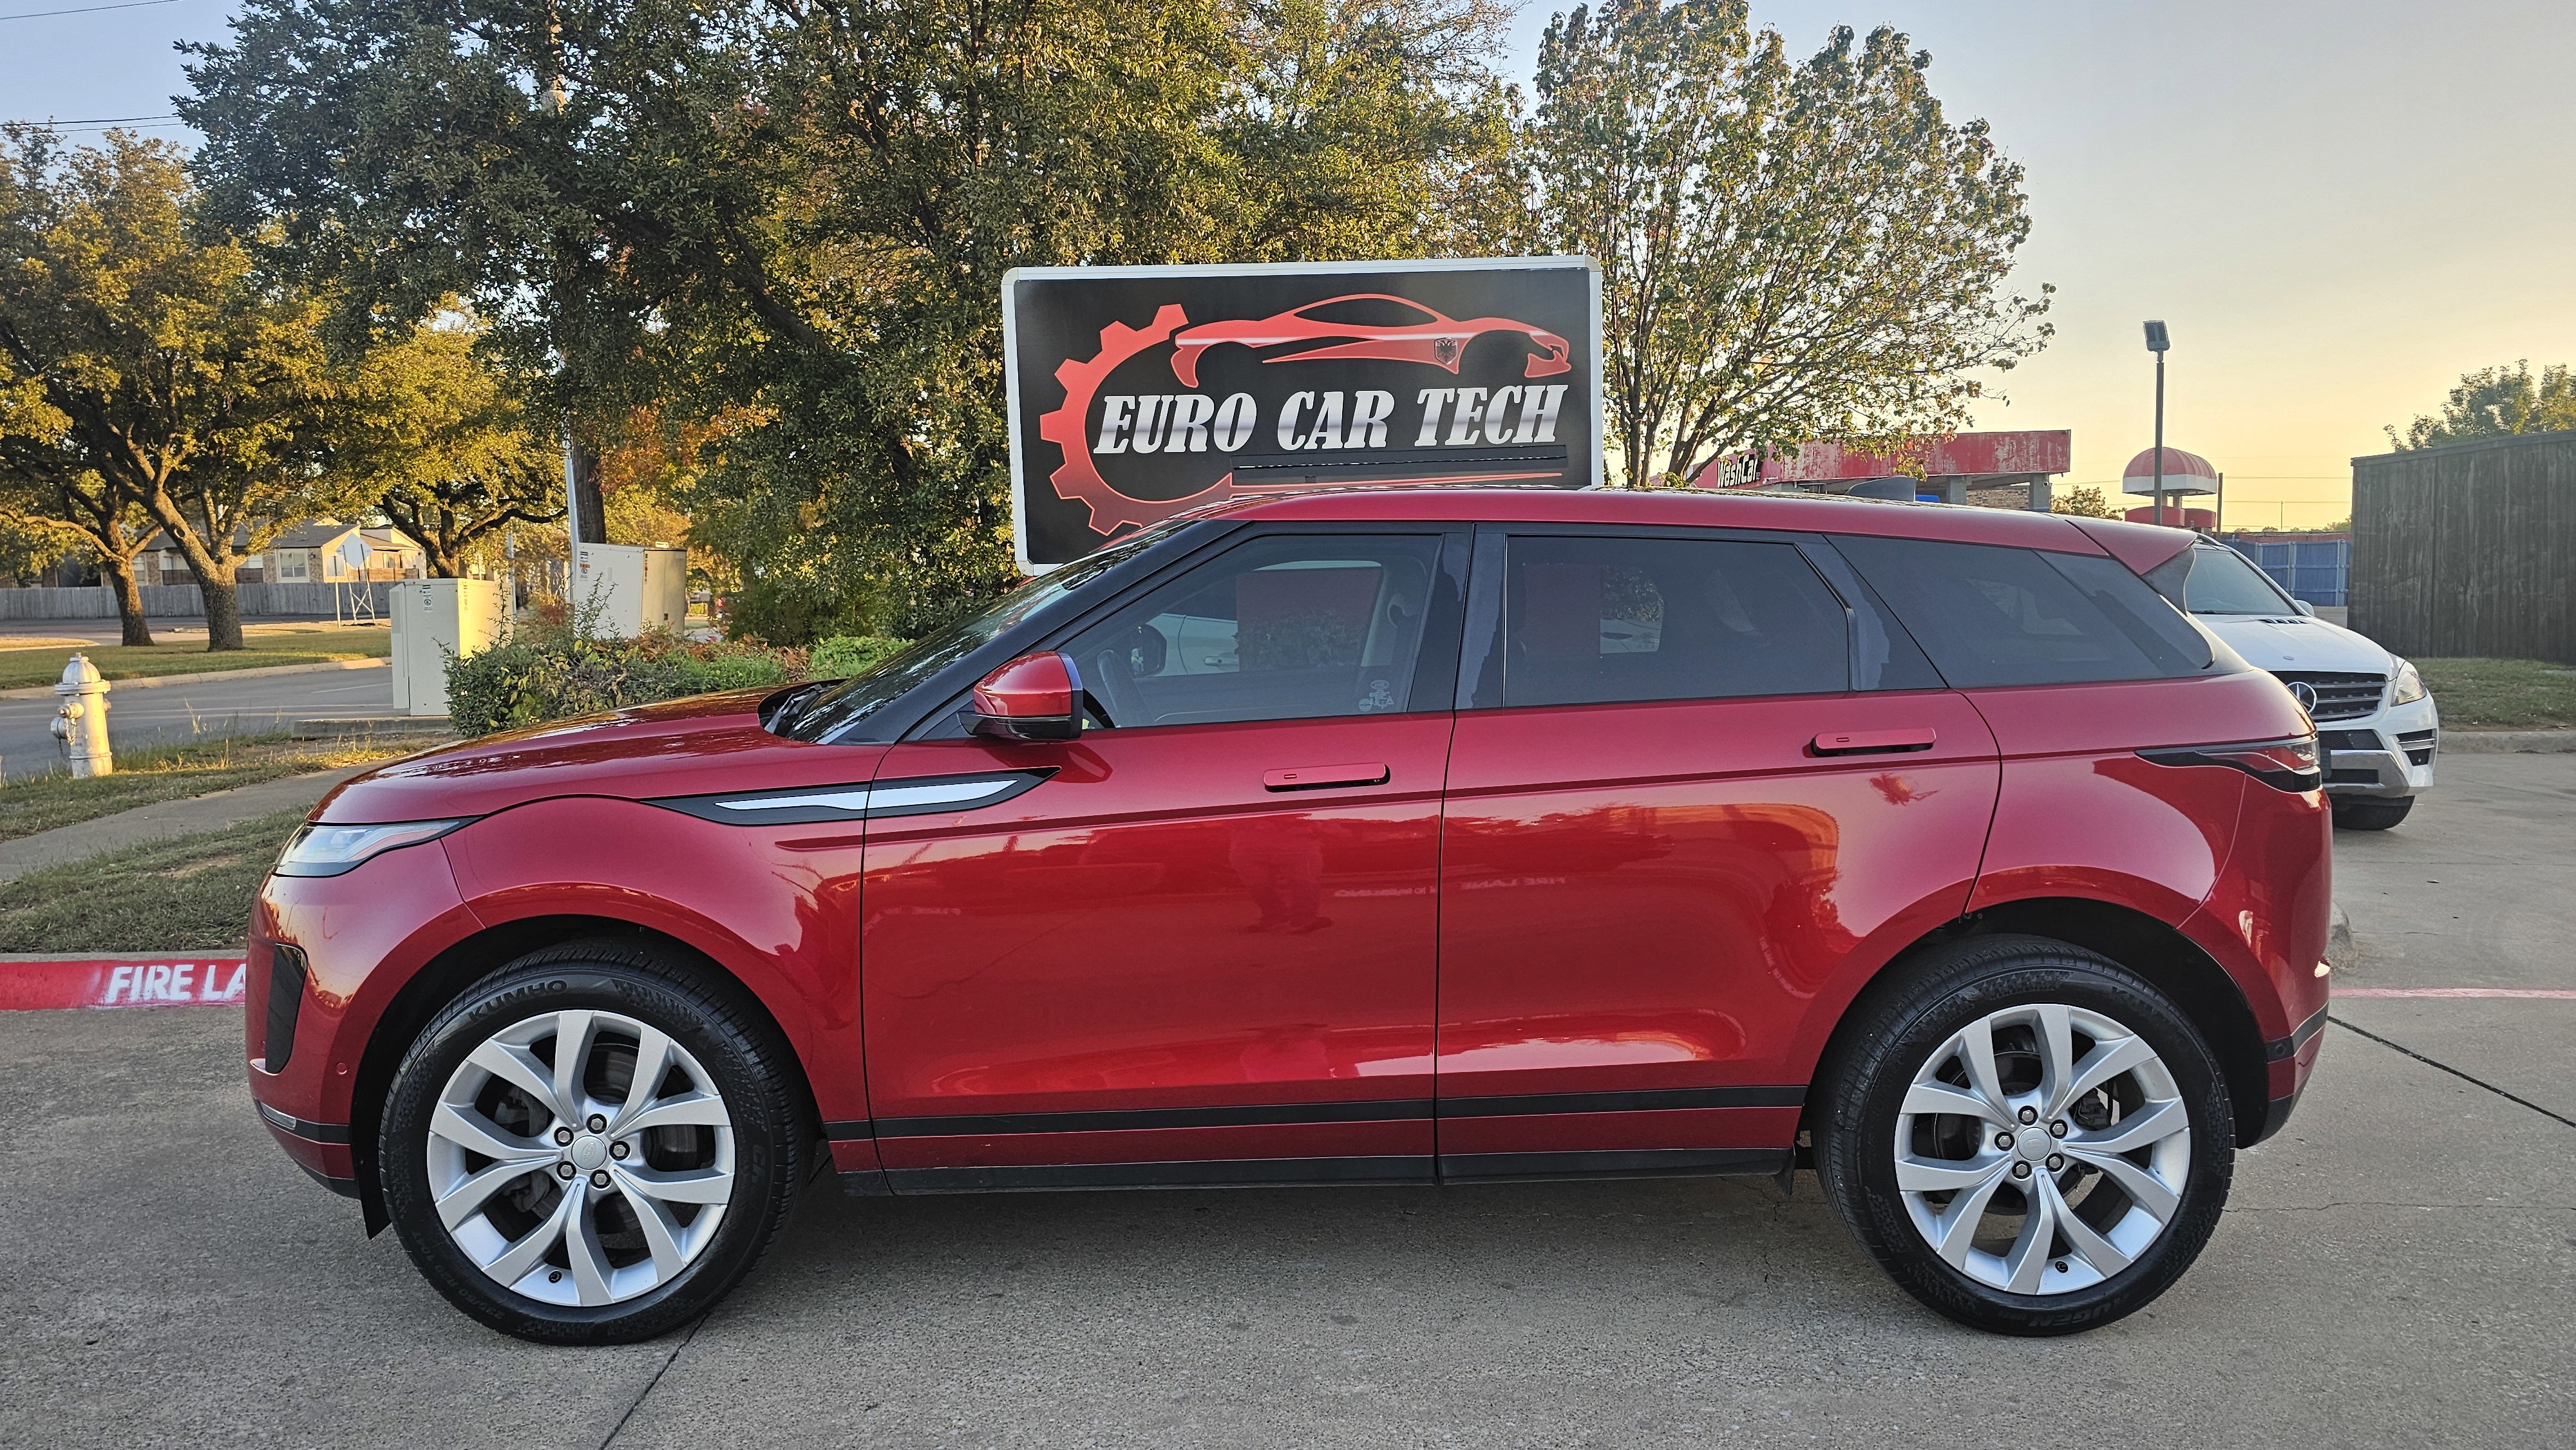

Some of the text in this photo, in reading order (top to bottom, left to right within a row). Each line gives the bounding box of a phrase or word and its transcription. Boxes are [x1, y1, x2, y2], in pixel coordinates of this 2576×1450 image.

[1093, 384, 1569, 454] EURO CAR TECH
[104, 964, 194, 1003] FIRE
[468, 980, 567, 1021] KUMHO
